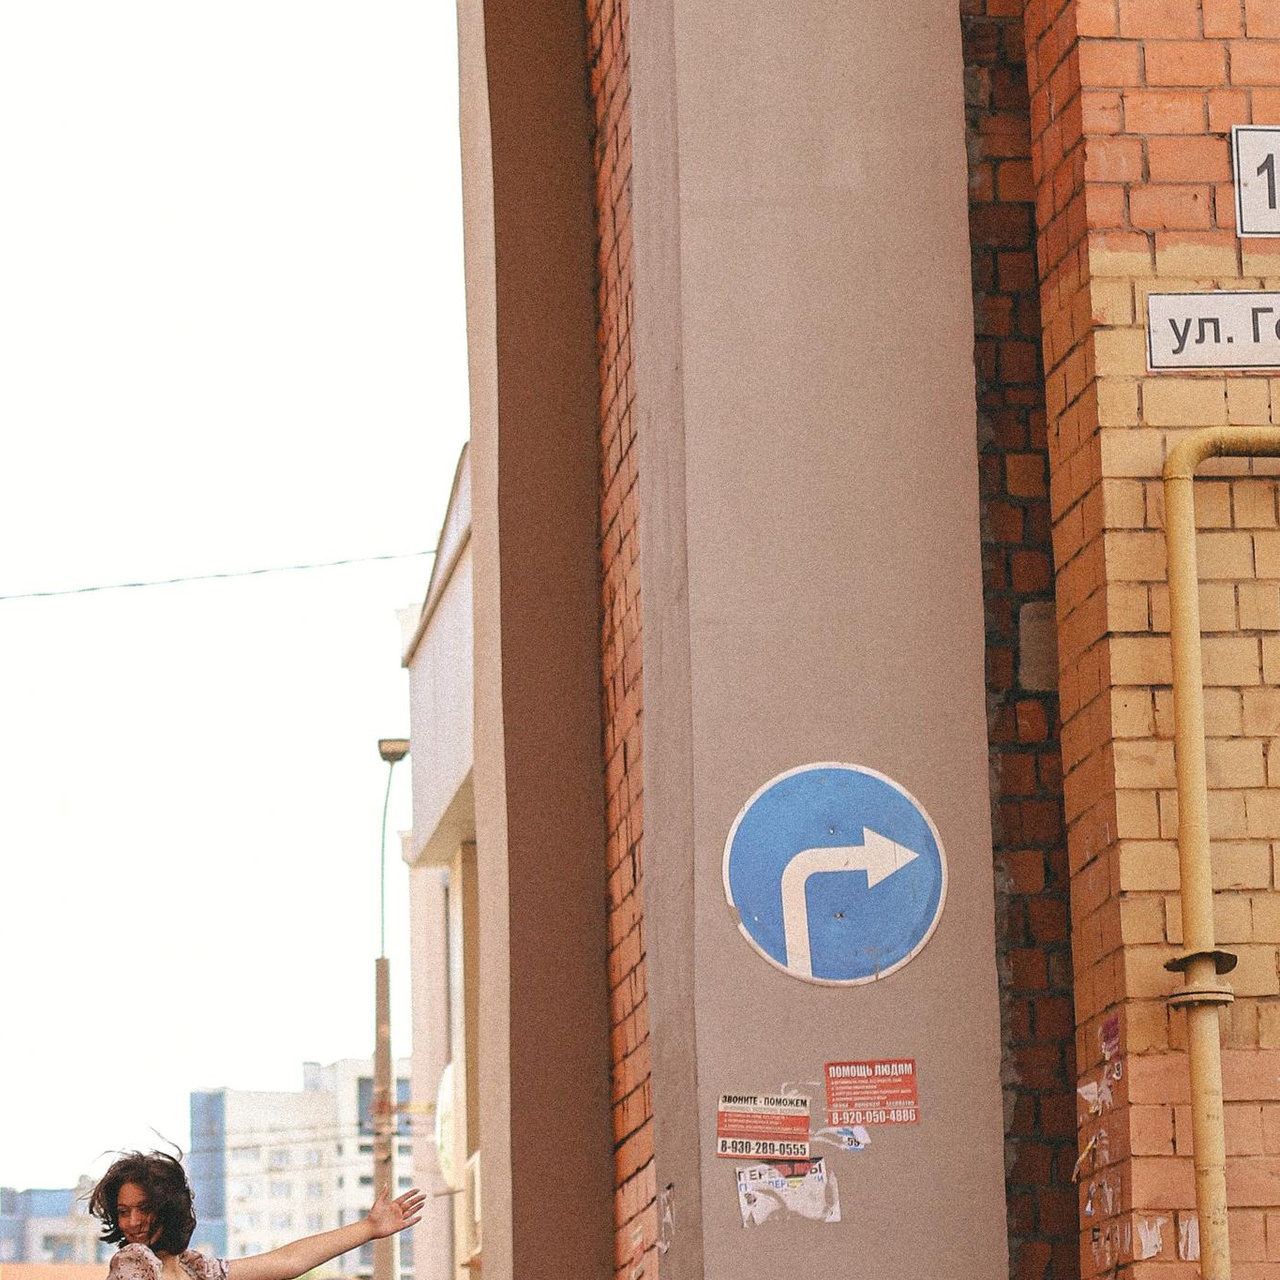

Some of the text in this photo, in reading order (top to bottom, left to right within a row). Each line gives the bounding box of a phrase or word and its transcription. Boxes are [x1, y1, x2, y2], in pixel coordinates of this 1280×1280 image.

[1168, 318, 1234, 354] ул.
[829, 1063, 913, 1078] ПОМОЩЬ ЛЮДЯМ
[722, 1095, 758, 1105] ЗВОНИТЕ
[764, 1097, 807, 1107] ПОМОЖЕМ
[721, 1140, 807, 1156] 8-930-289-0555
